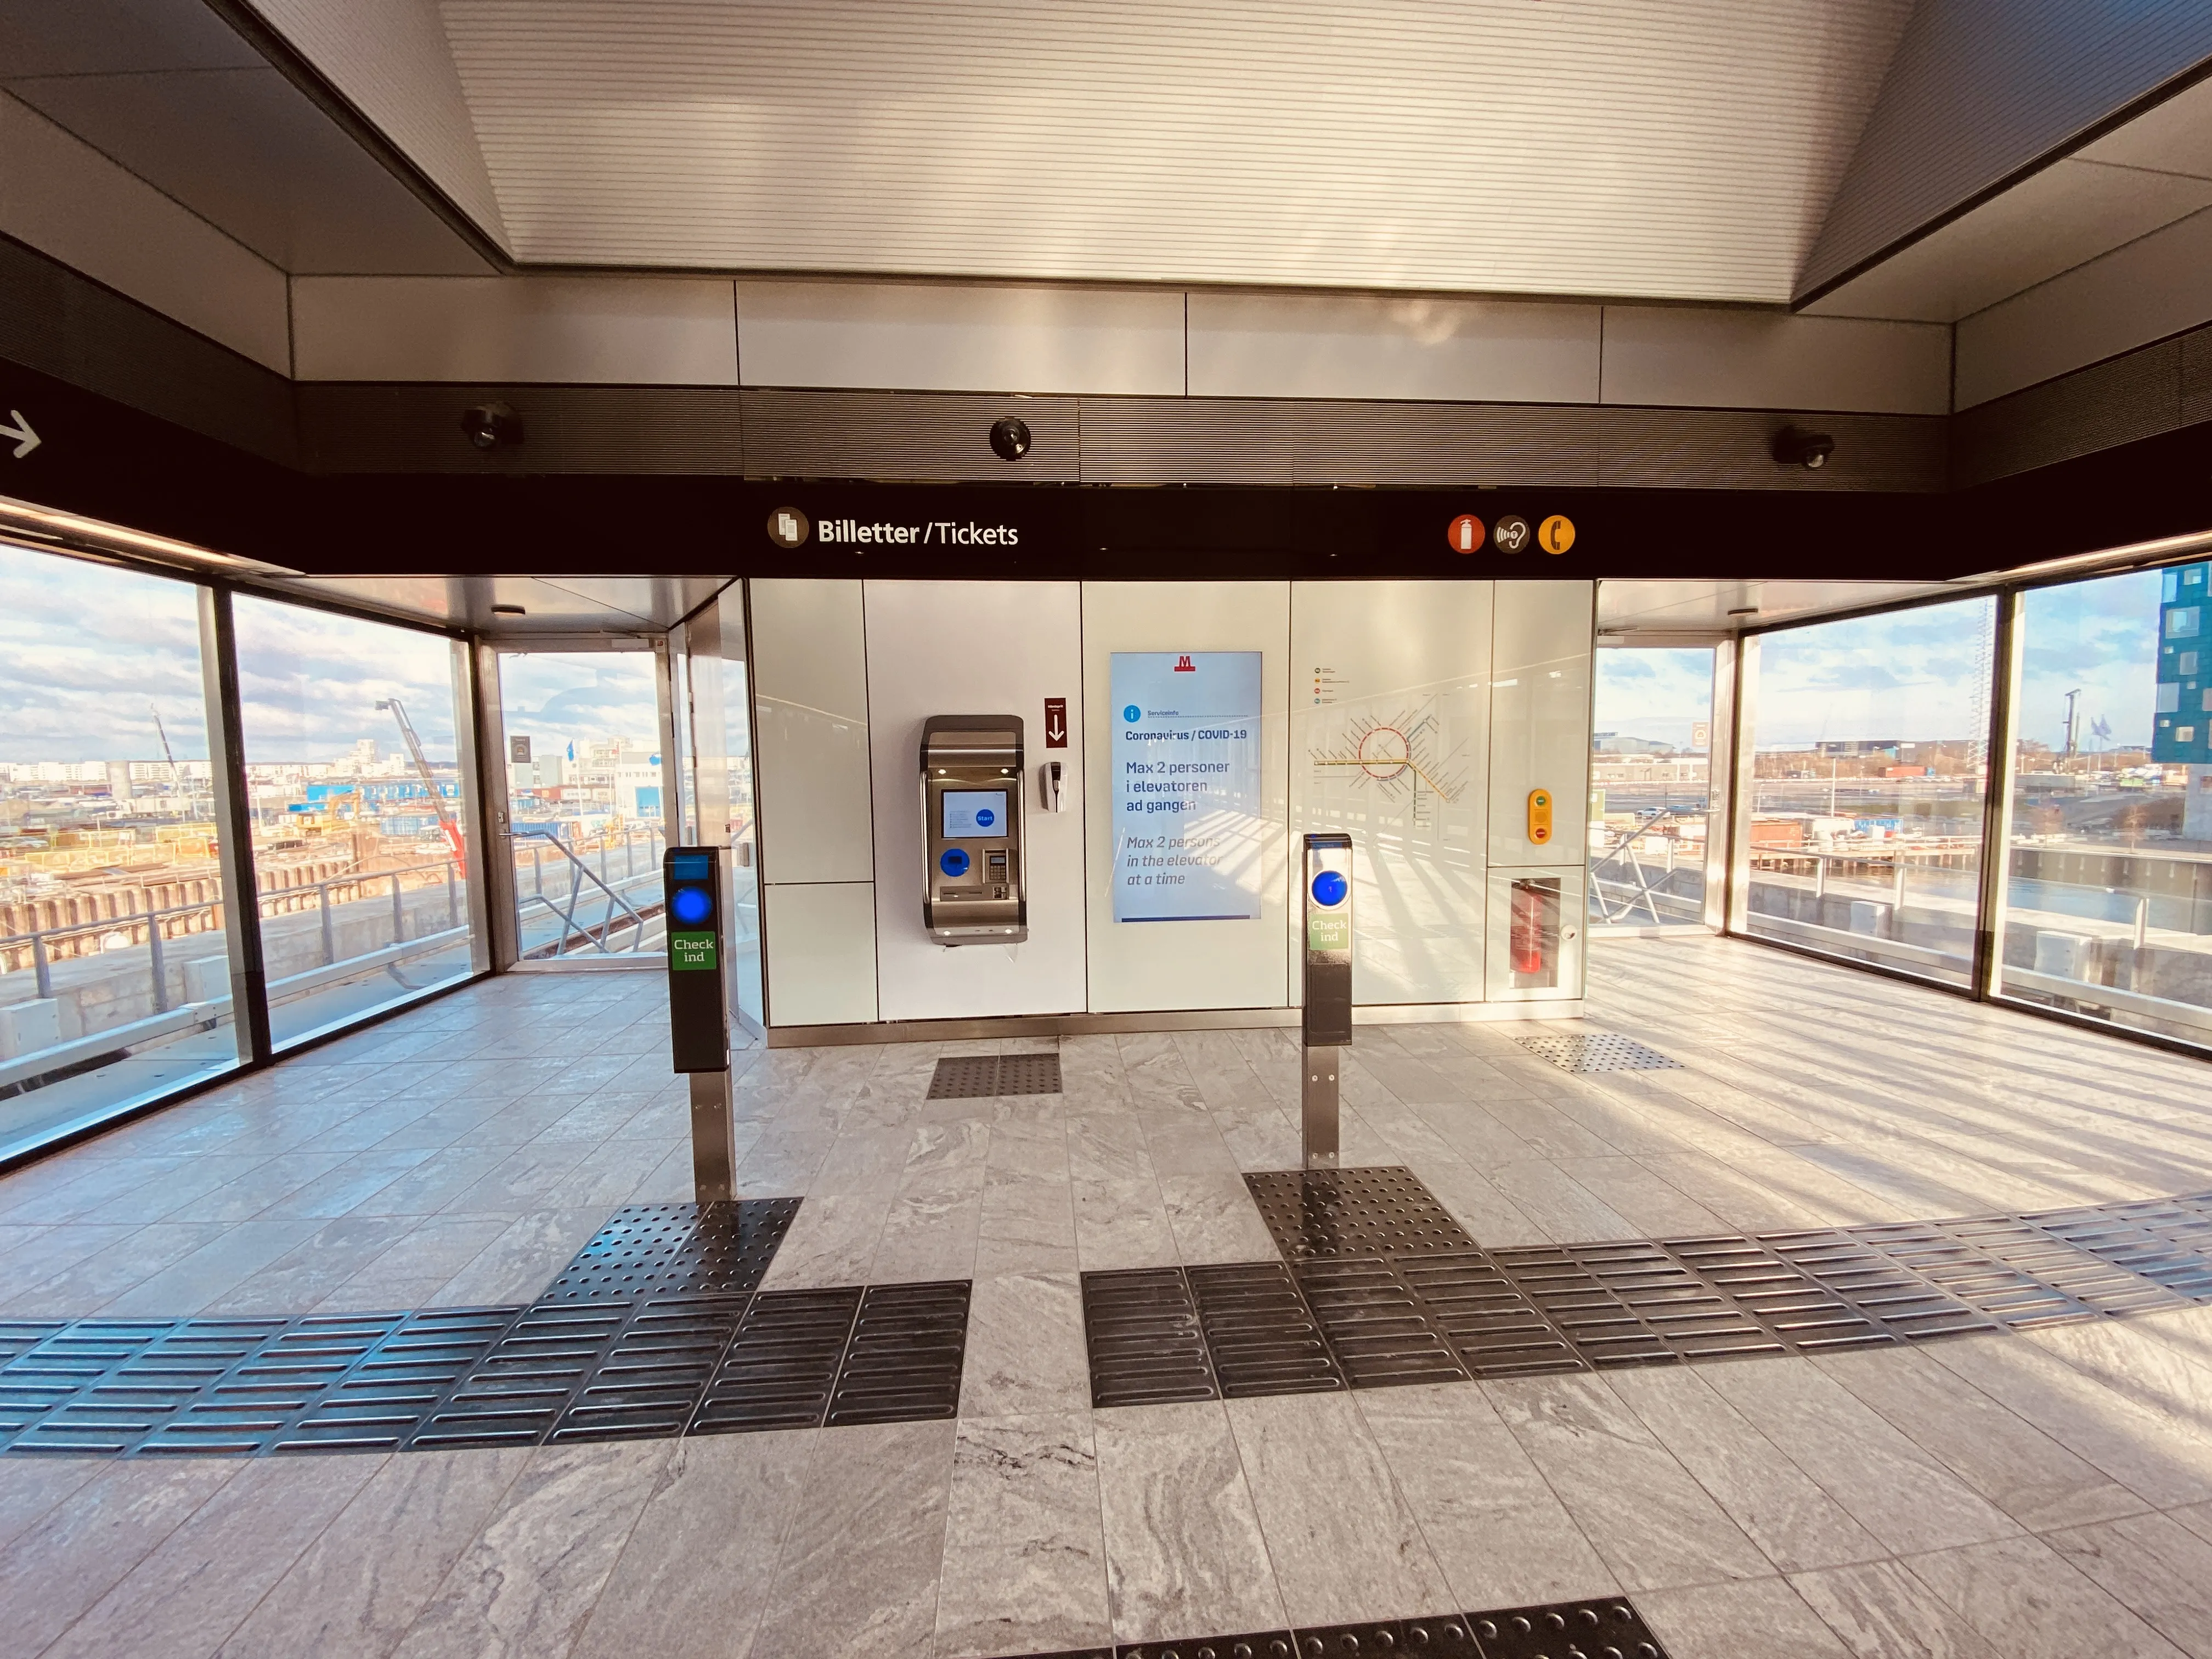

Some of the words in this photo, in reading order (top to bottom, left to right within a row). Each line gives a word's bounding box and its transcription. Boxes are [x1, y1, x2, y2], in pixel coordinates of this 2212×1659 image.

[819, 520, 920, 544] Billetter
[1125, 730, 1189, 741] Coronavirus
[1198, 729, 1247, 740] COVID-19
[1126, 761, 1154, 774] Max
[1157, 761, 1166, 774] 2
[1169, 762, 1230, 776] personer
[1126, 780, 1130, 793] i
[1133, 781, 1207, 792] elevatoren
[1126, 799, 1143, 811] ad
[1146, 800, 1196, 814] gangen
[1127, 837, 1154, 849] Max
[1156, 836, 1166, 848] 2
[1127, 854, 1138, 867] in
[1142, 855, 1164, 867] the
[1127, 874, 1141, 885] at
[1144, 876, 1153, 885] a
[1156, 872, 1186, 884] time
[1312, 919, 1347, 930] Check
[1321, 931, 1339, 941] ind
[674, 939, 714, 950] Check
[684, 951, 705, 962] ind
